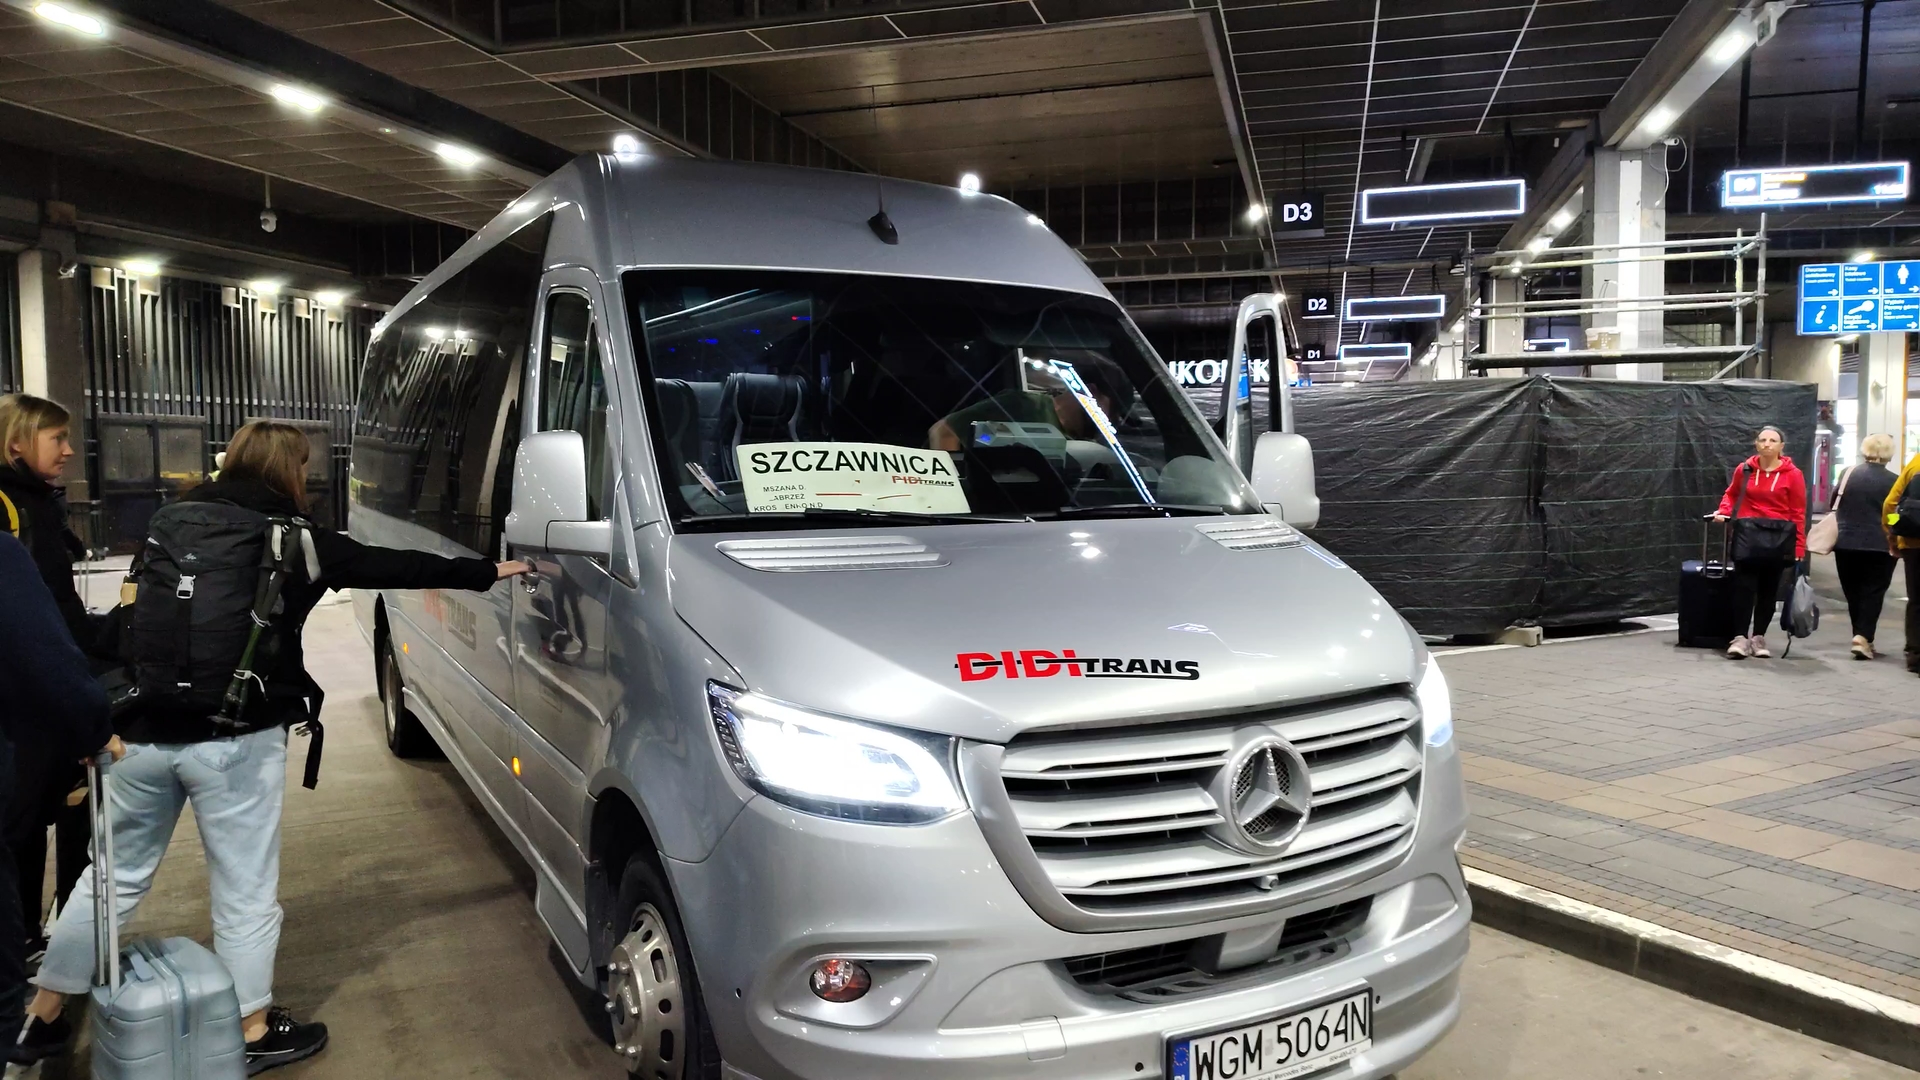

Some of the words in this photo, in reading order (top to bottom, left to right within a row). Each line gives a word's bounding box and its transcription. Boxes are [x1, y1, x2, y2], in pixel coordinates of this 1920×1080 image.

[1283, 202, 1312, 222] D3
[1308, 298, 1327, 310] D2
[1307, 350, 1321, 359] D1
[751, 450, 951, 475] SZCZAWNICA
[763, 485, 797, 493] MSZANA
[1195, 1029, 1262, 1080] WGM
[1276, 997, 1367, 1064] 5064N
